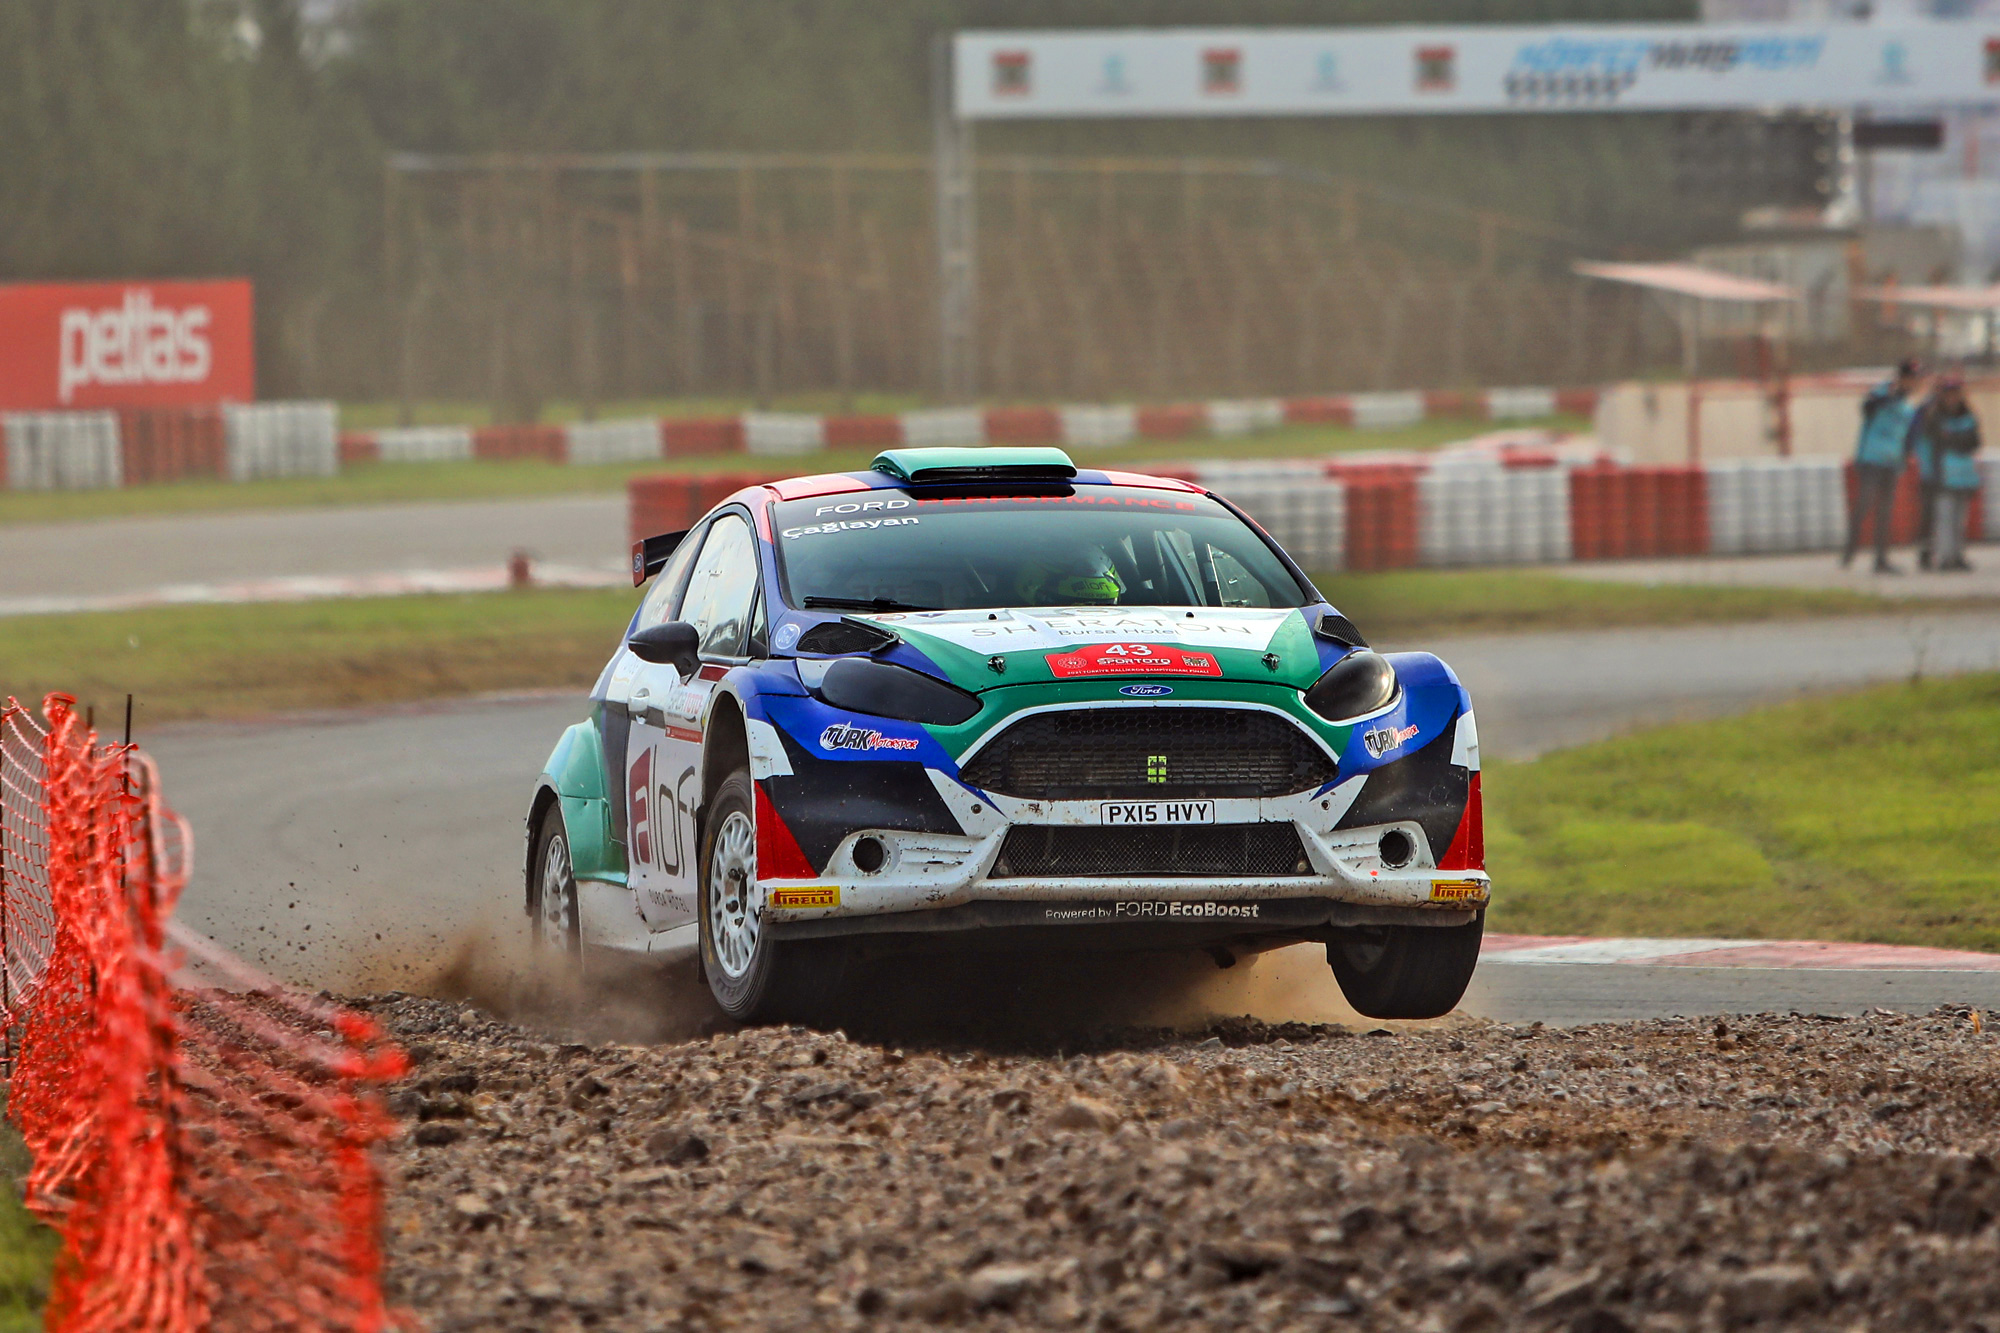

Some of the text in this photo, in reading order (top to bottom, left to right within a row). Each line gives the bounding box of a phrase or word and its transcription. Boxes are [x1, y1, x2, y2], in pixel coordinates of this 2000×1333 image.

[815, 499, 910, 517] FORD
[782, 515, 920, 540] Çağlayan
[971, 619, 1252, 637] SHERATON
[1058, 628, 1179, 637] Bursa Hotel
[1105, 644, 1153, 656] 43
[1130, 685, 1162, 695] Ford
[1109, 804, 1207, 822] PX15 HVY
[774, 890, 834, 905] PIRELLI
[1045, 908, 1096, 919] Powered
[1098, 908, 1112, 917] by
